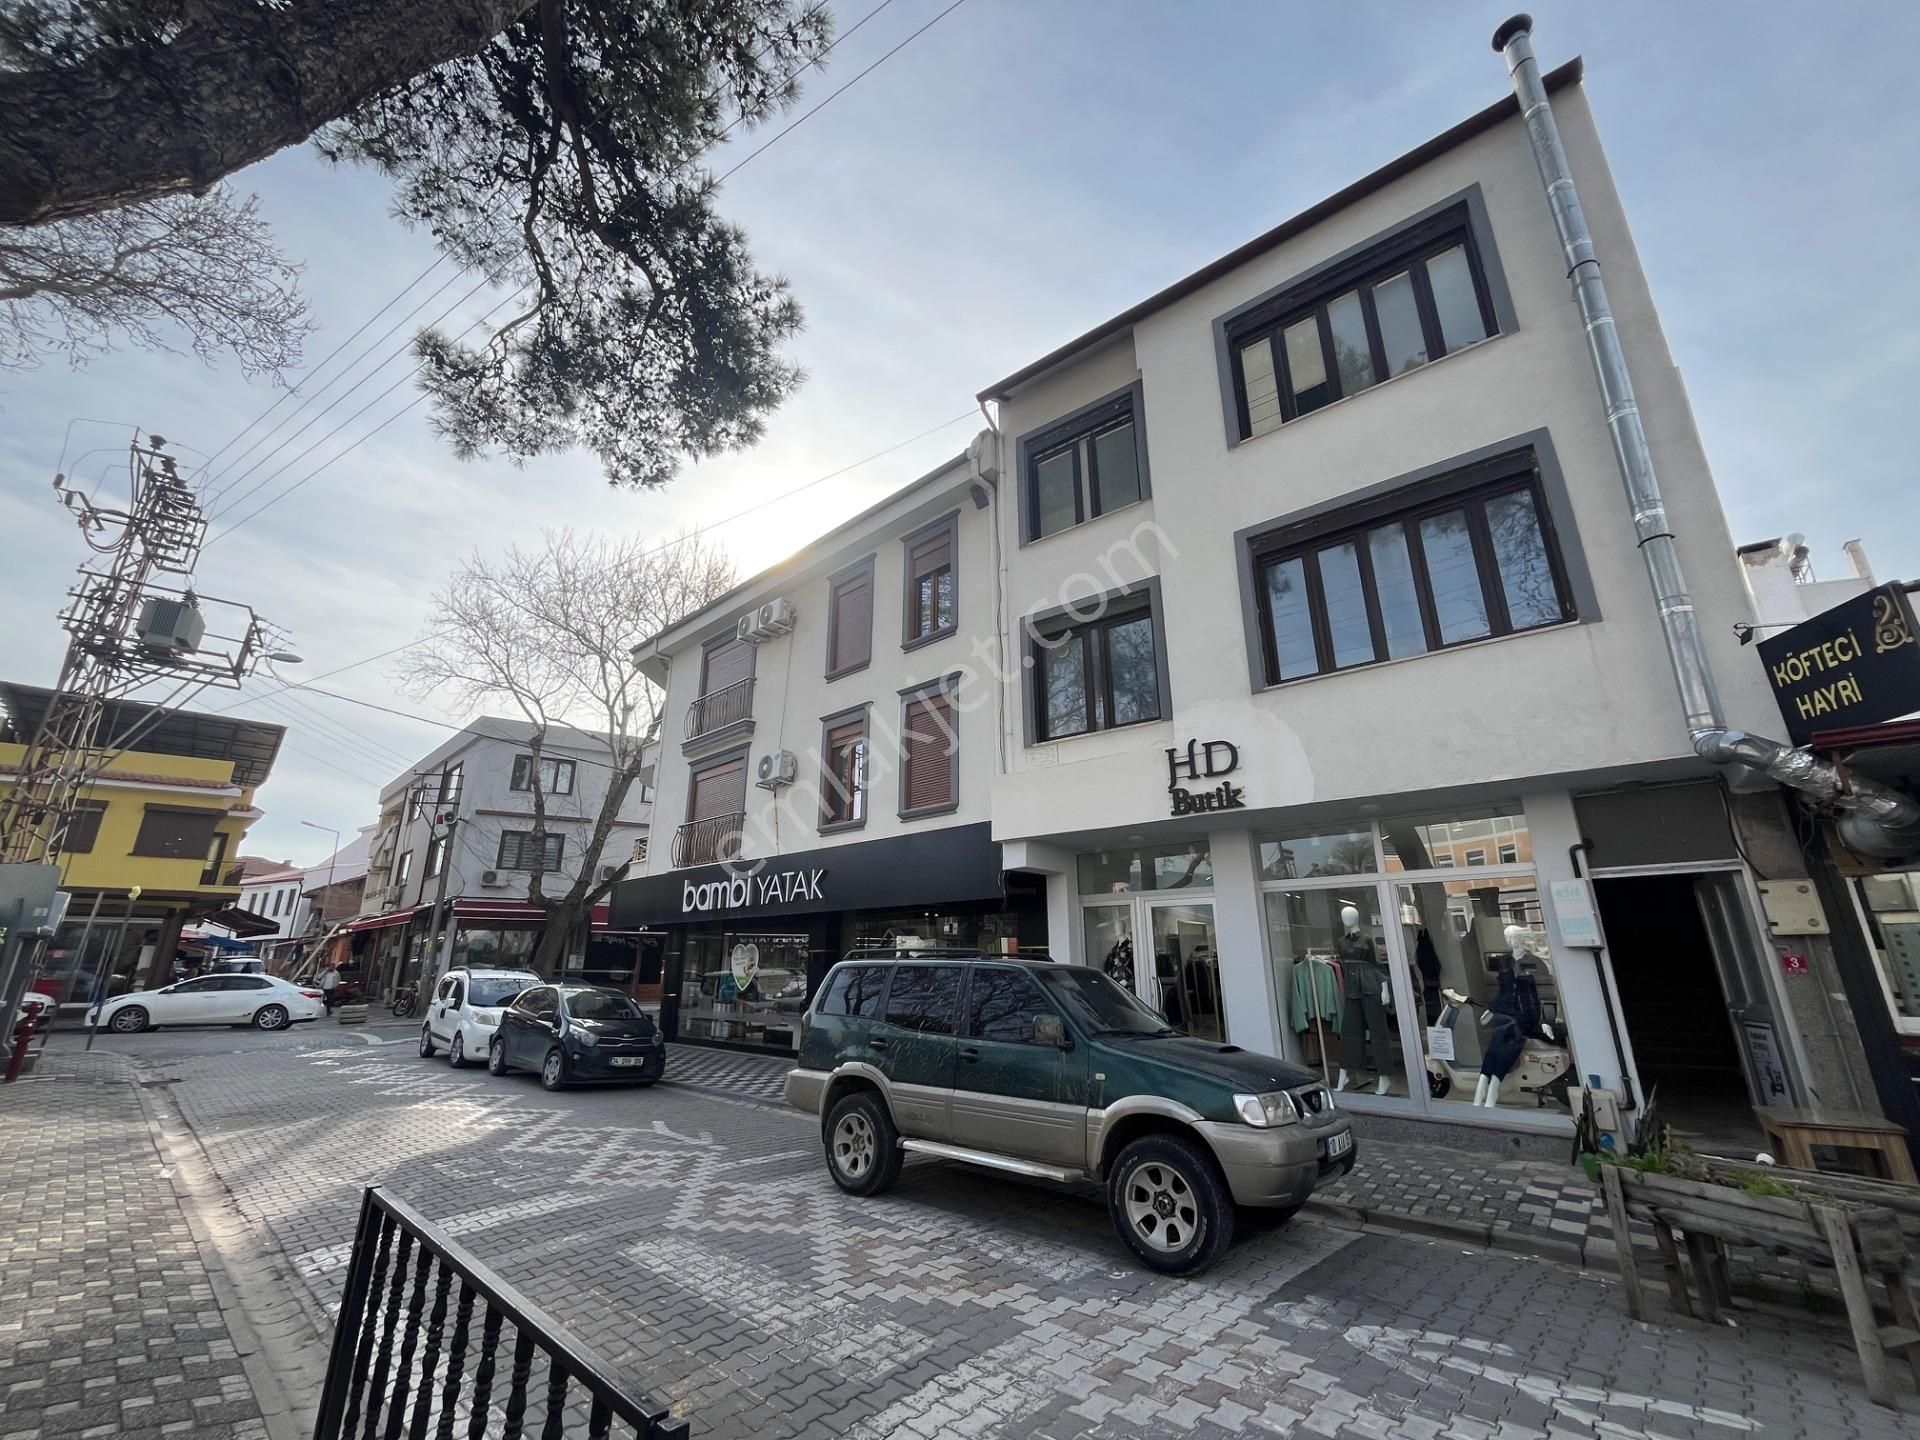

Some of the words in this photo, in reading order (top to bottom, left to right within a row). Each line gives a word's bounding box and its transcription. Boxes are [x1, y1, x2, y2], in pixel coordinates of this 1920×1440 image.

[1773, 627, 1863, 688] KÖFTECİ
[1796, 672, 1863, 720] HAYRİ
[1165, 738, 1239, 790] HD
[1168, 781, 1246, 816] Butik
[682, 870, 752, 913] bambi
[757, 869, 824, 905] YATAK
[1789, 957, 1800, 968] 3
